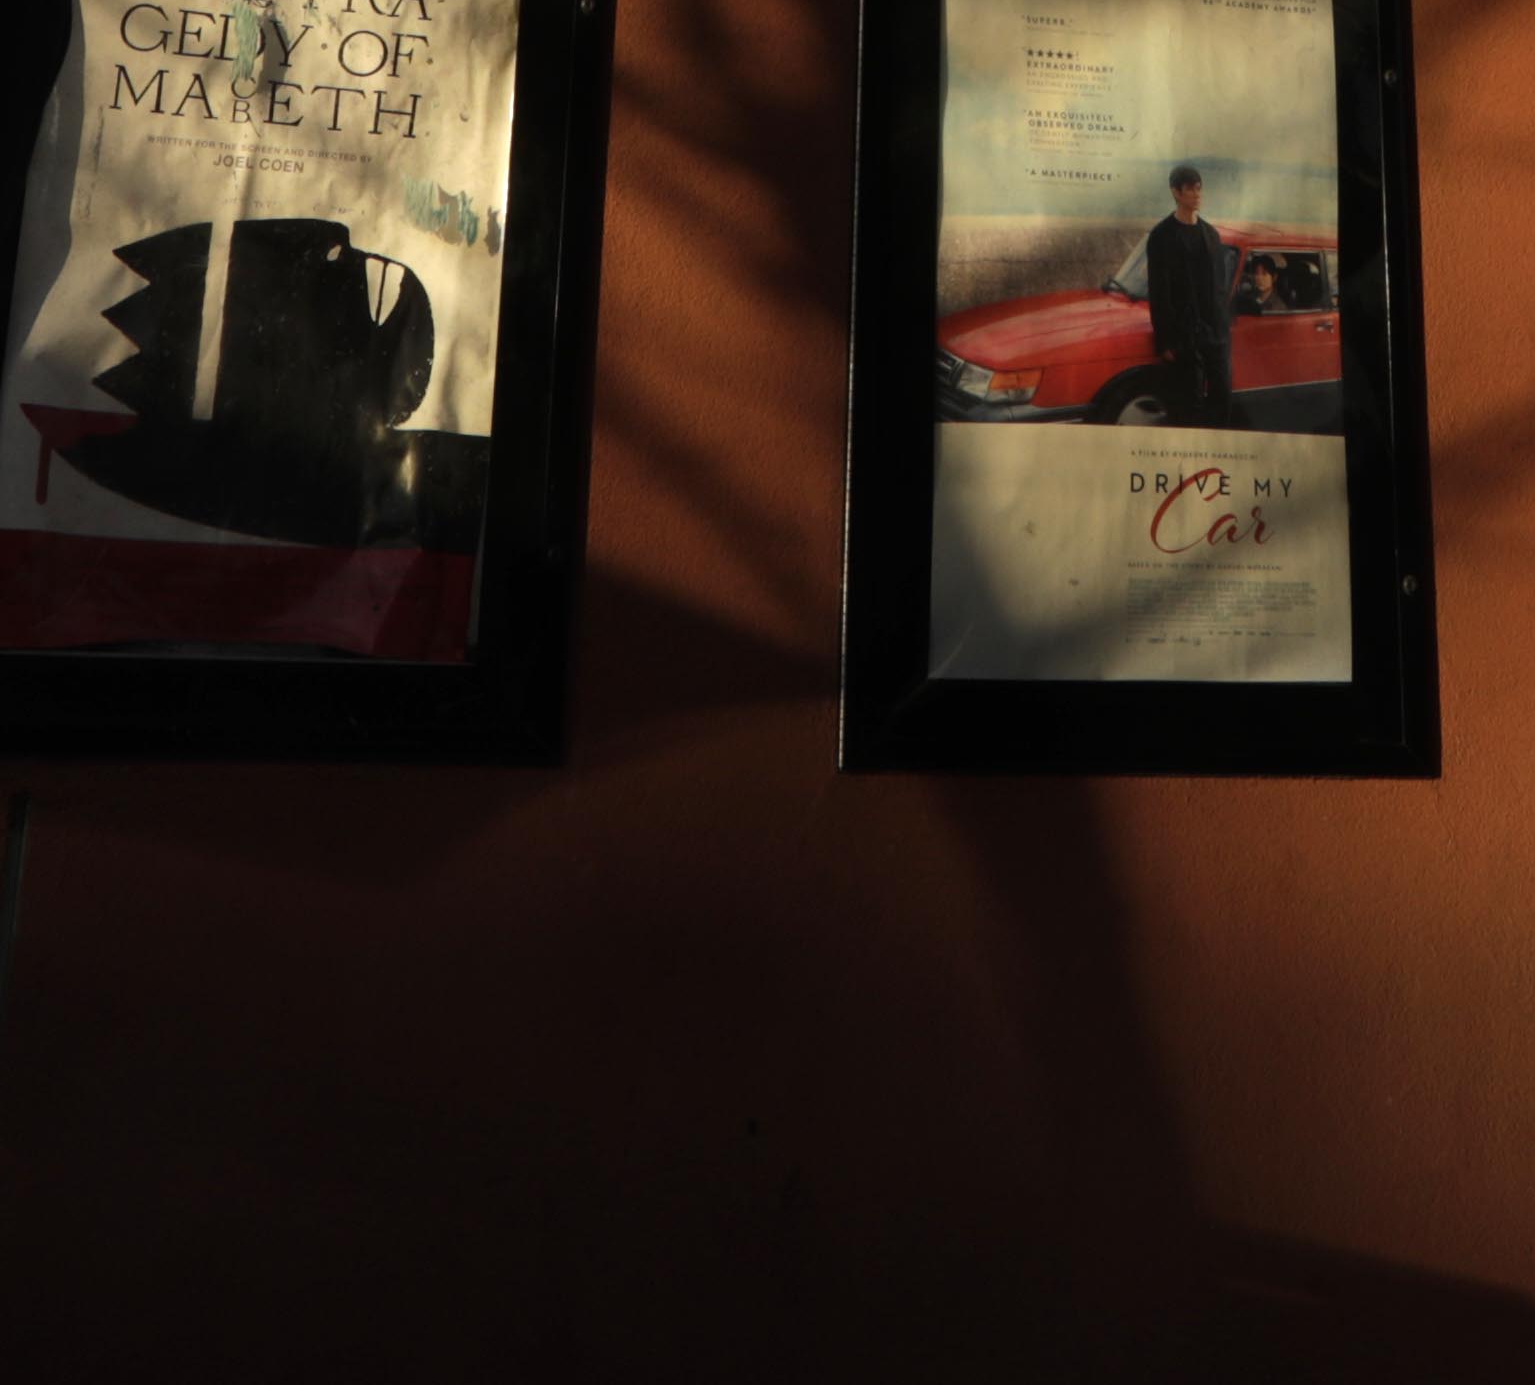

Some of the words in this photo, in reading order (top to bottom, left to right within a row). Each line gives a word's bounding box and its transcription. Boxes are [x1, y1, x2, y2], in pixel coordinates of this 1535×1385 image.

[338, 30, 430, 78] OF
[213, 153, 254, 170] JOEL
[259, 157, 304, 174] COEN
[1130, 472, 1232, 496] DRIVE
[1254, 478, 1292, 498] MY
[1150, 467, 1274, 554] Car
